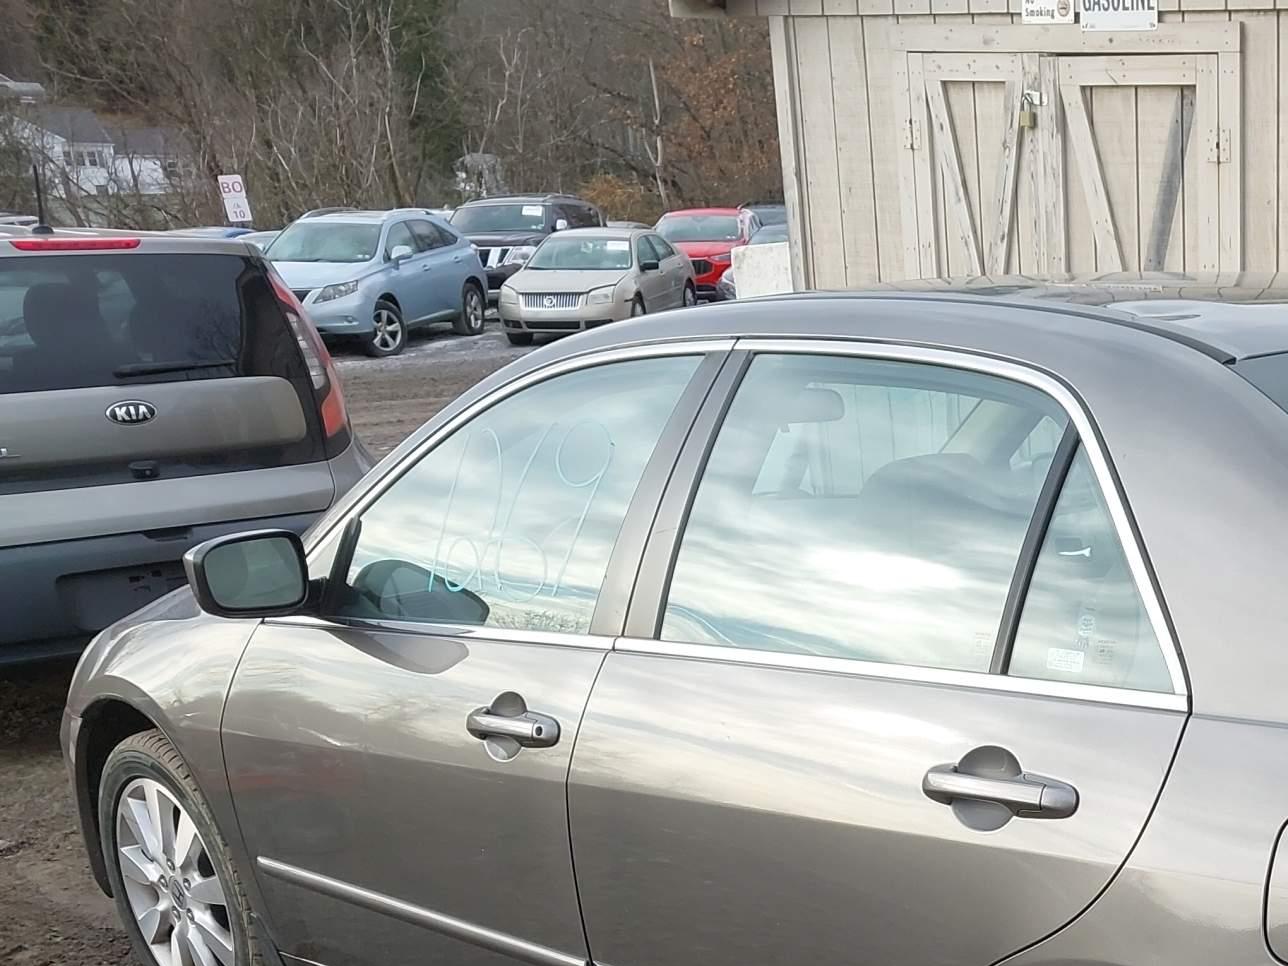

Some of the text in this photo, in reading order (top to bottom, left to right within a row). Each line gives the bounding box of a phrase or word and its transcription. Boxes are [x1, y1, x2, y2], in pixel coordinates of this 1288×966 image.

[1083, 0, 1155, 12] GASOLINE
[1025, 7, 1055, 19] Smoking
[114, 405, 151, 421] KIA
